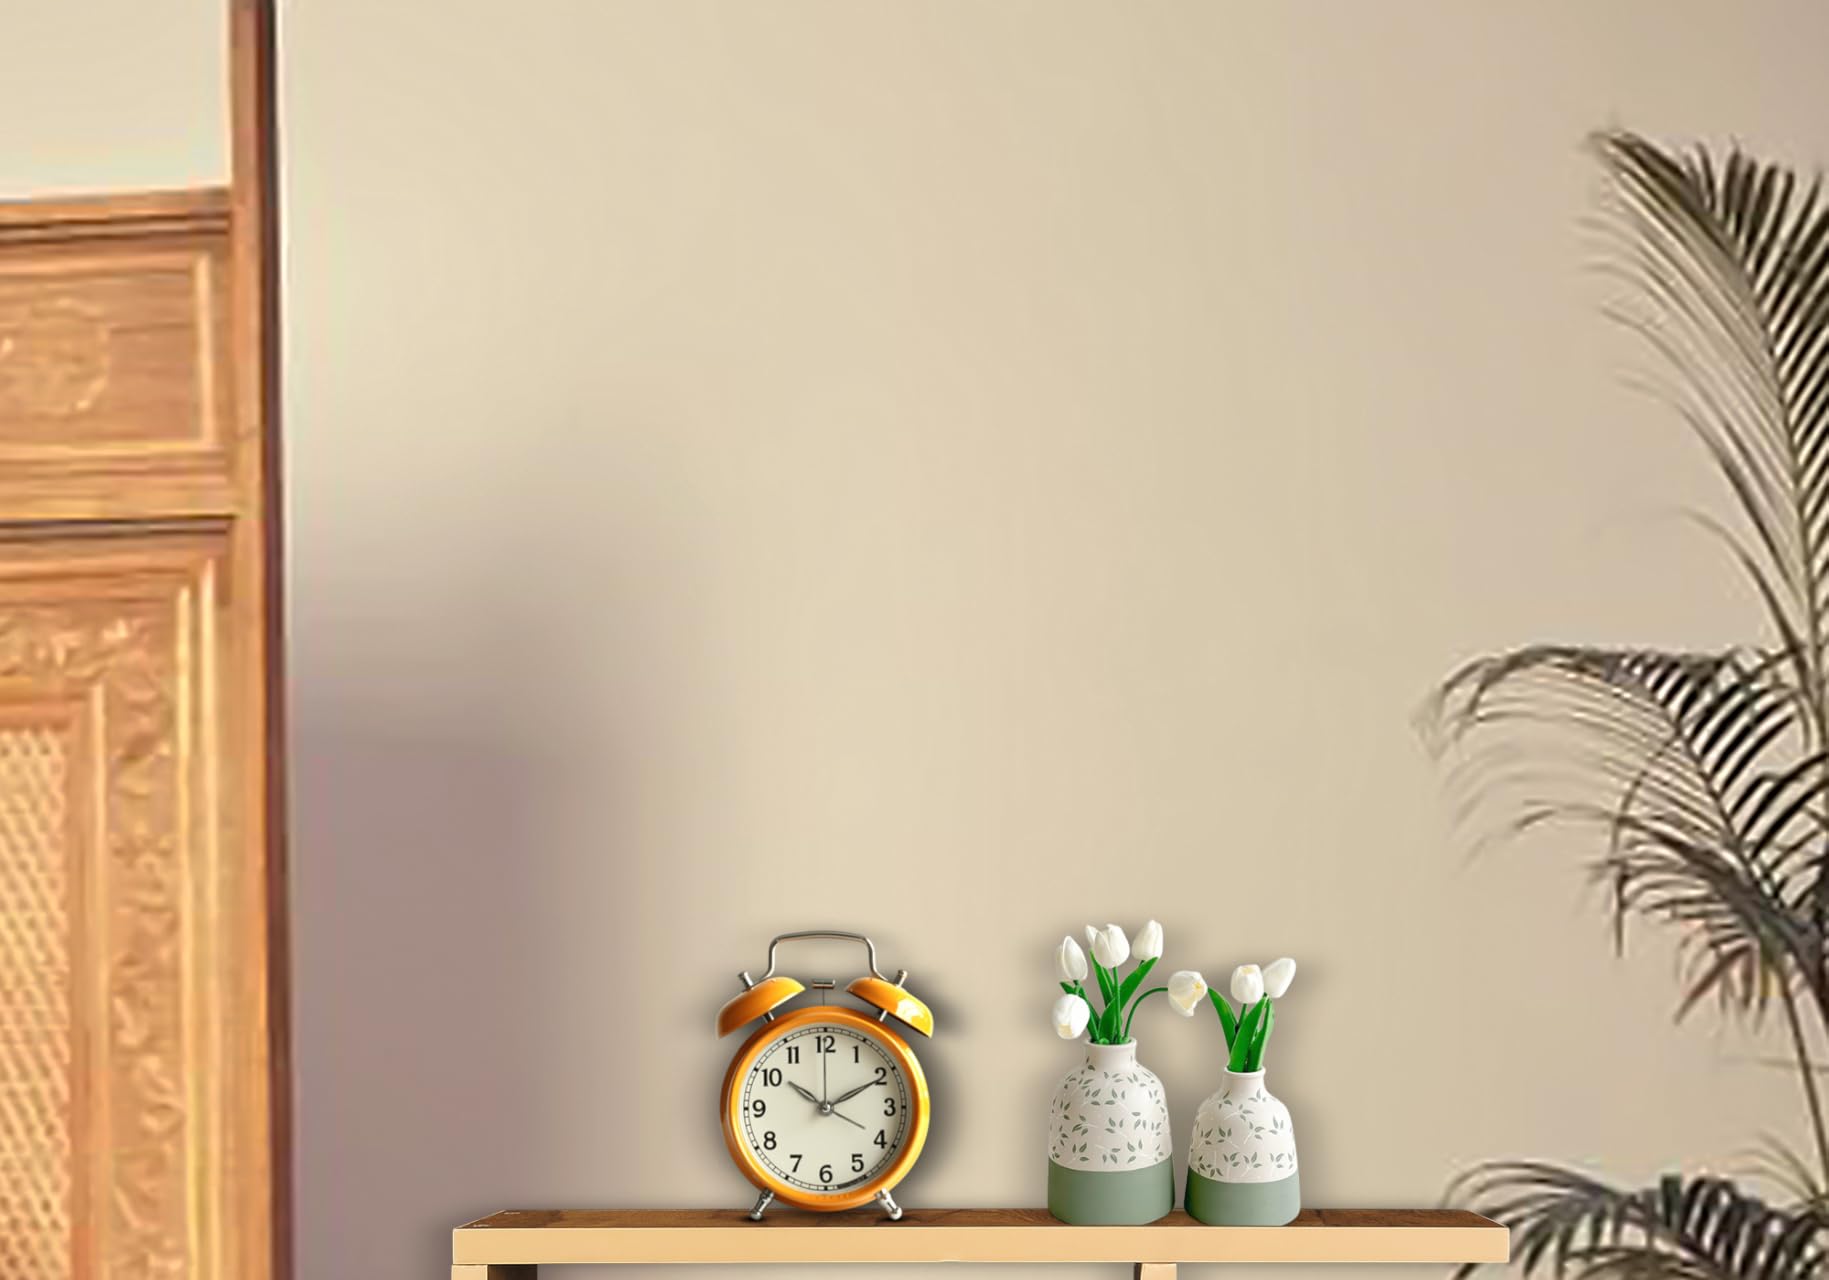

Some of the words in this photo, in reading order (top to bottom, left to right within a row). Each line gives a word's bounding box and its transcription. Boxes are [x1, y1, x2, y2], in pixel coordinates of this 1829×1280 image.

[816, 1036, 836, 1053] 12
[786, 1046, 800, 1064] 11
[853, 1046, 859, 1063] 1
[762, 1068, 782, 1087] 10
[874, 1067, 887, 1085] 2
[752, 1100, 766, 1118] 9
[884, 1098, 896, 1117] 3
[763, 1131, 777, 1150] 8
[874, 1129, 887, 1149] 4
[789, 1154, 803, 1173] 7
[851, 1154, 864, 1172] 5
[819, 1165, 833, 1183] 6
